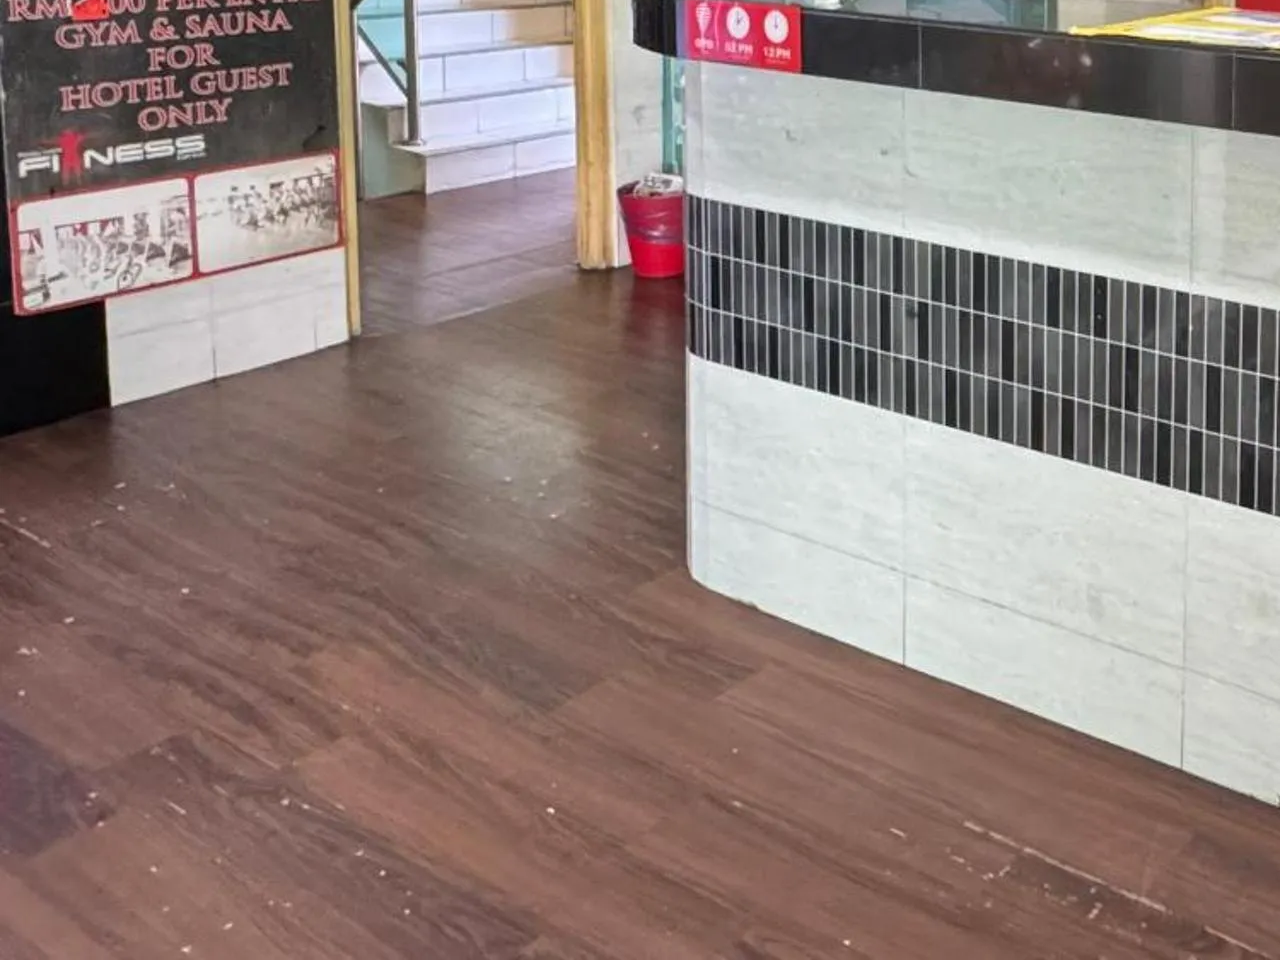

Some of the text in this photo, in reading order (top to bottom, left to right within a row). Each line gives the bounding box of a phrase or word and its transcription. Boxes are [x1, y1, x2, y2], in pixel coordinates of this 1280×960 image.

[55, 9, 293, 49] GYM & SAUNA
[147, 42, 220, 72] FOR
[59, 62, 293, 112] HOTEL GUEST
[137, 97, 233, 132] ONLY
